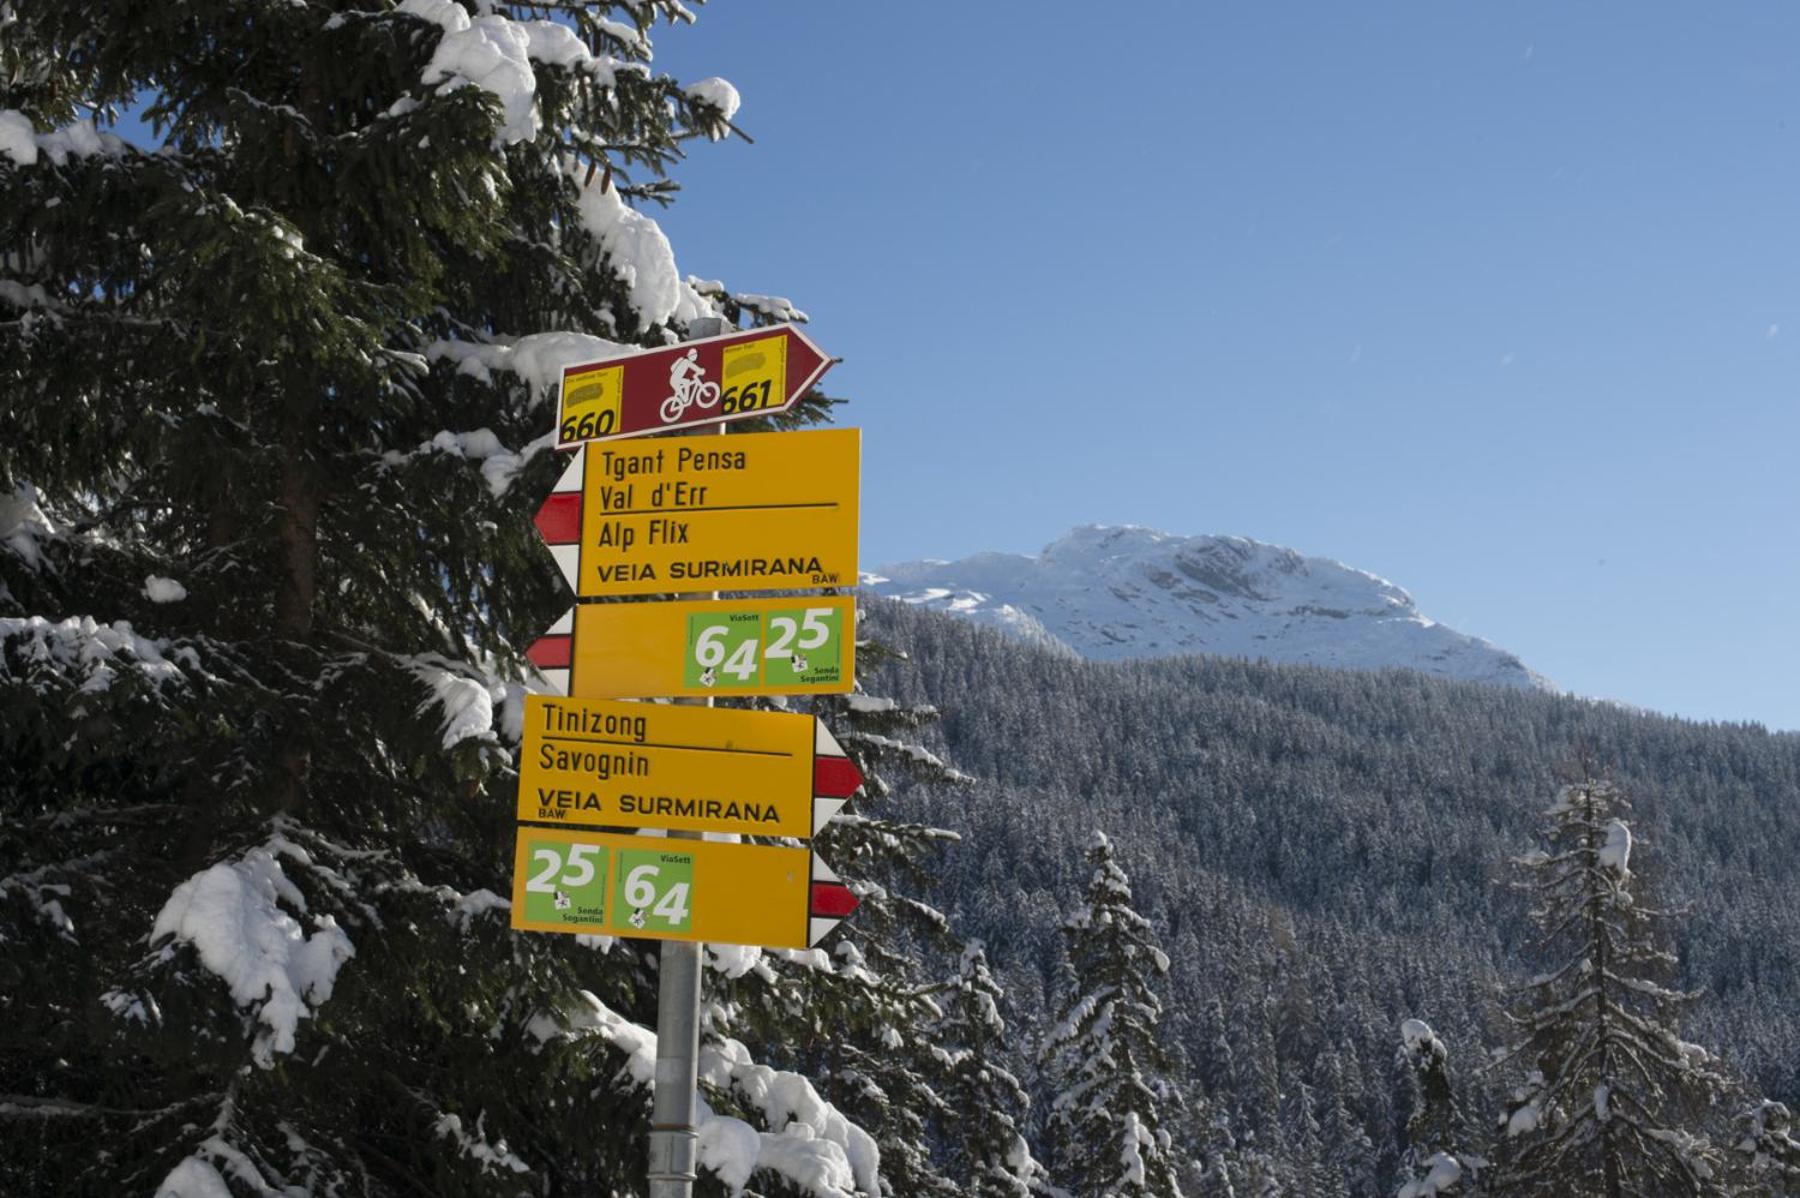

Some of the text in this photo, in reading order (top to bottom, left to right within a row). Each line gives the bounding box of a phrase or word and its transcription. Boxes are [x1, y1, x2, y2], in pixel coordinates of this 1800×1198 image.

[721, 380, 772, 414] 661
[561, 409, 615, 441] 660
[602, 448, 745, 482] Tgant Pensa
[601, 482, 707, 510] Val d'Err
[598, 520, 688, 552] Alp Flix
[598, 557, 823, 582] VEIA SURMIRANA
[812, 573, 838, 584] BAW
[765, 607, 833, 658] 25
[695, 626, 758, 680] 64
[542, 704, 647, 742] Tinizong
[540, 745, 648, 780] Savognin
[538, 788, 780, 823] VEIA SURMIRANA
[539, 809, 566, 819] BAW
[526, 844, 600, 892] 25
[624, 865, 689, 925] 64
